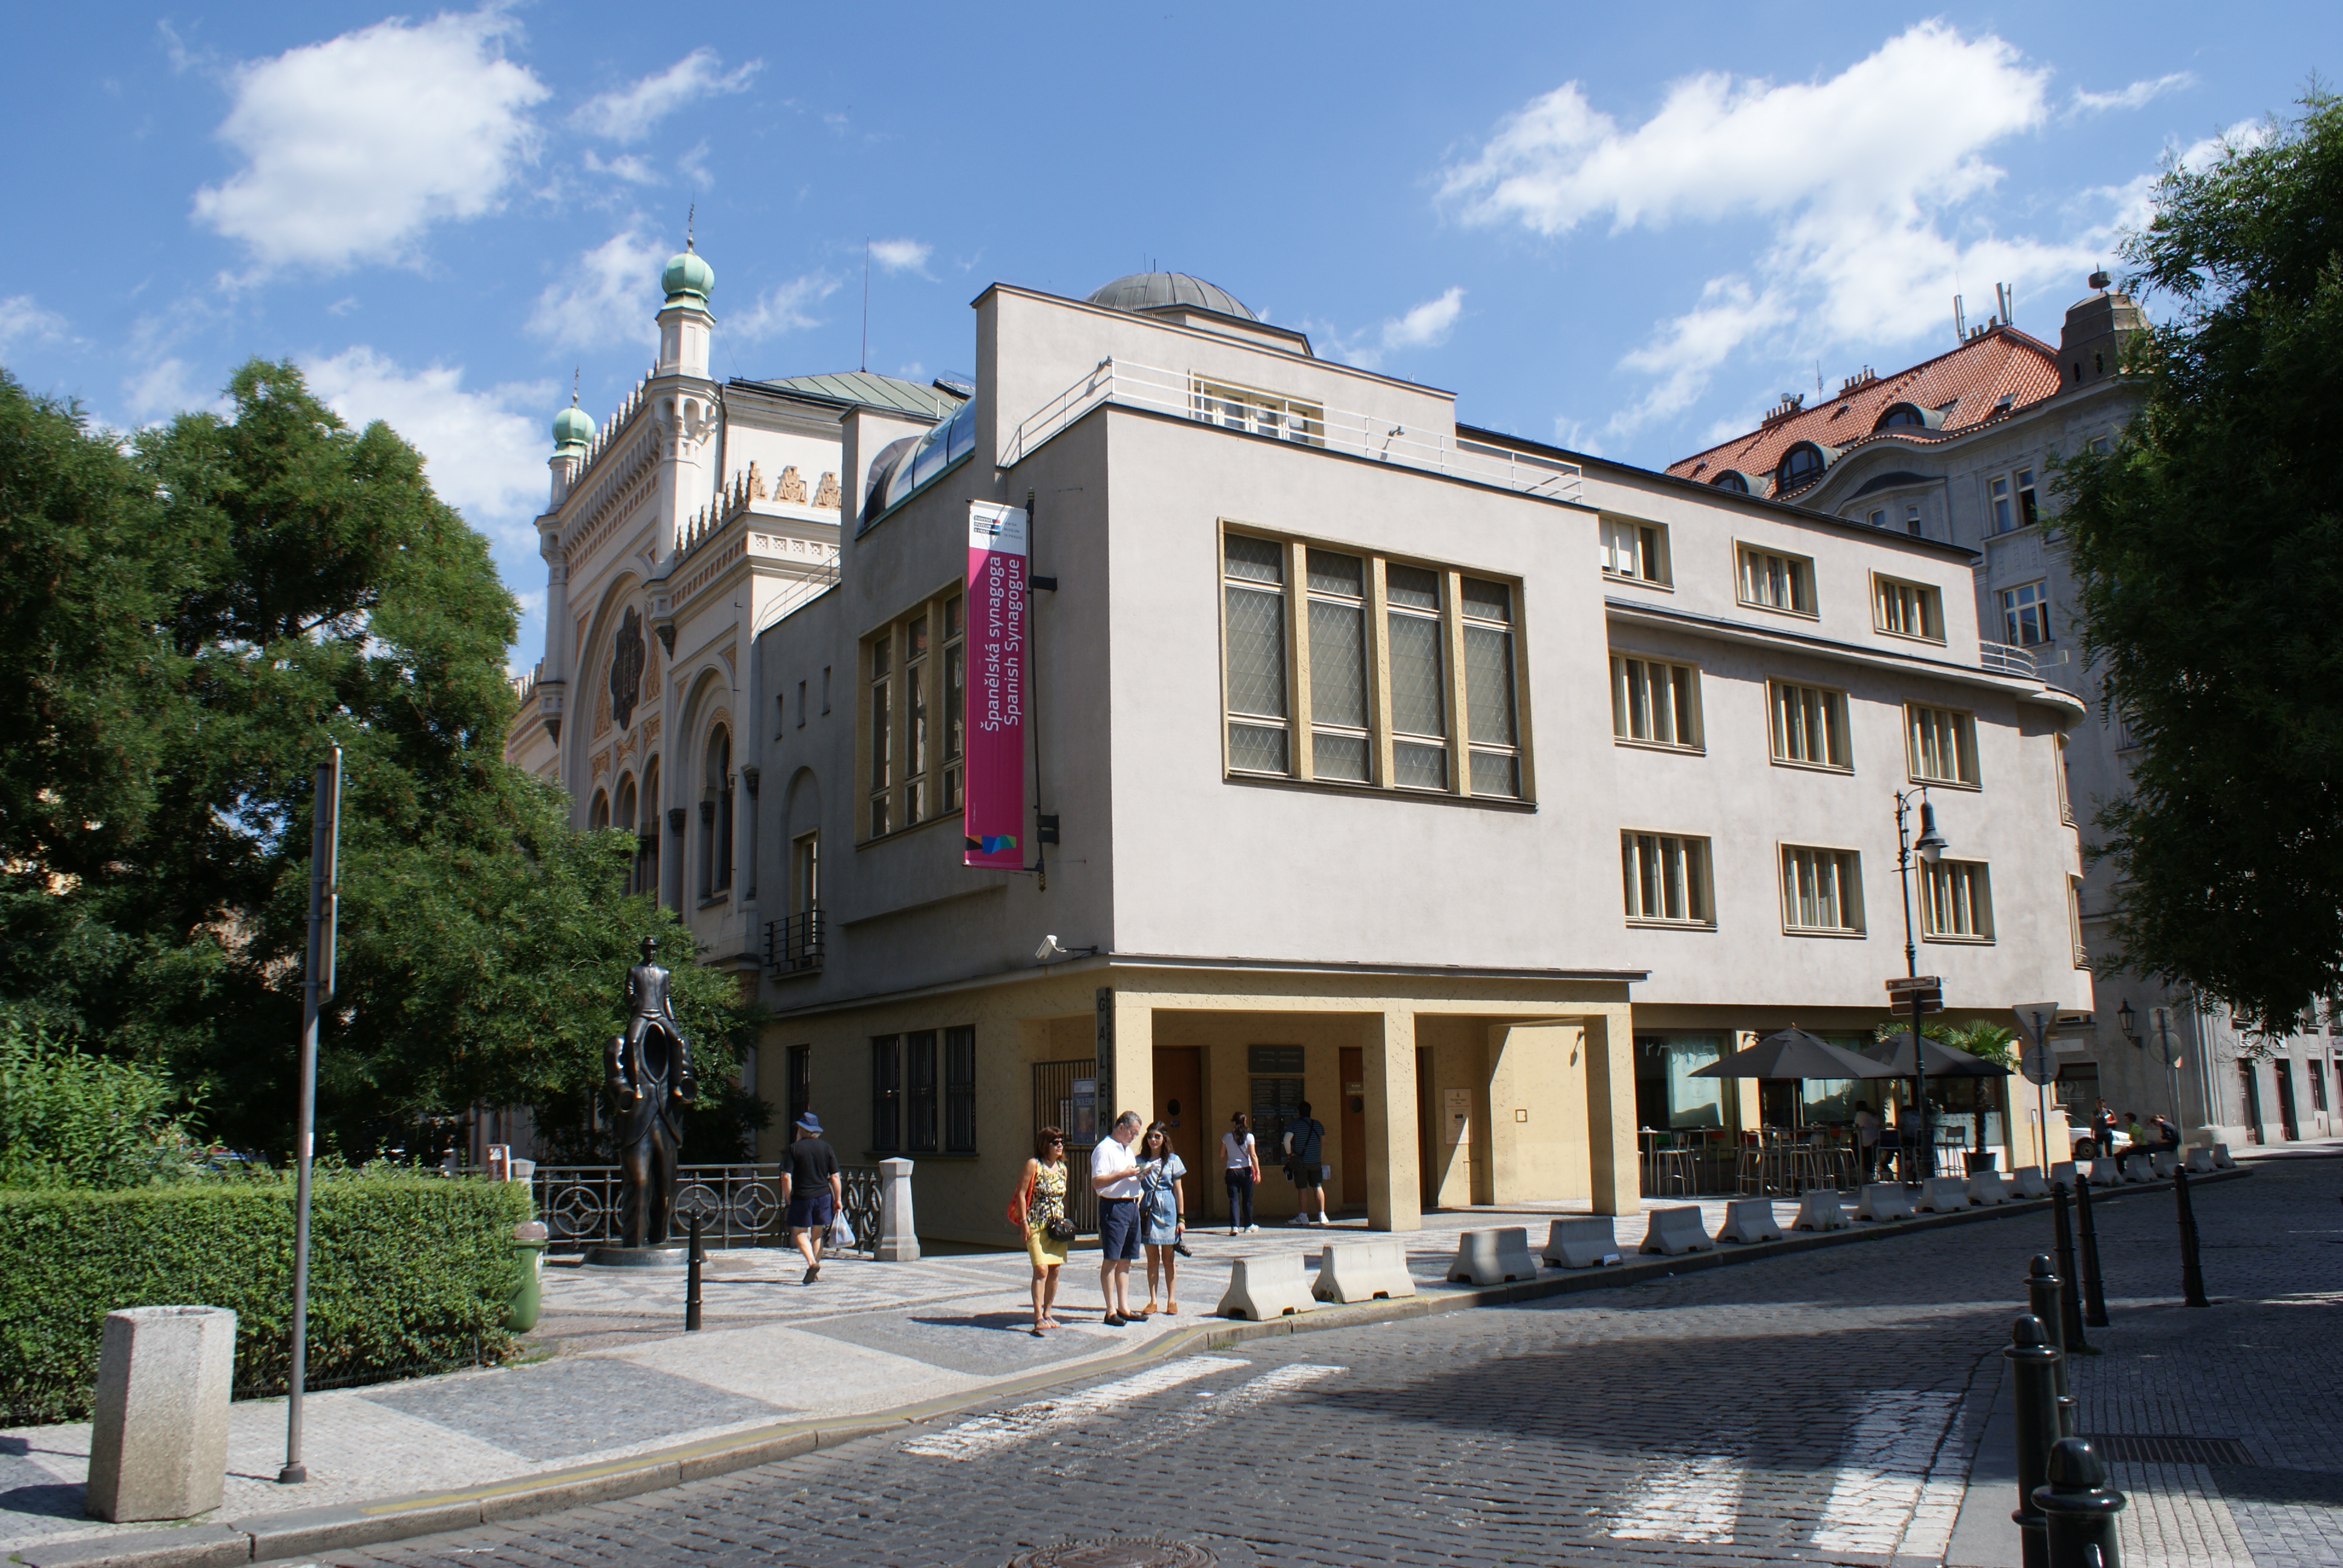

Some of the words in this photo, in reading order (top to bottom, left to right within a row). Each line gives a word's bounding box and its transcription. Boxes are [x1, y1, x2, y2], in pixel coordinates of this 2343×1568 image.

[989, 557, 1004, 638] synagoga
[1004, 559, 1023, 652] Synagogue
[980, 643, 1003, 731] Španělská
[1004, 658, 1021, 726] Spanish
